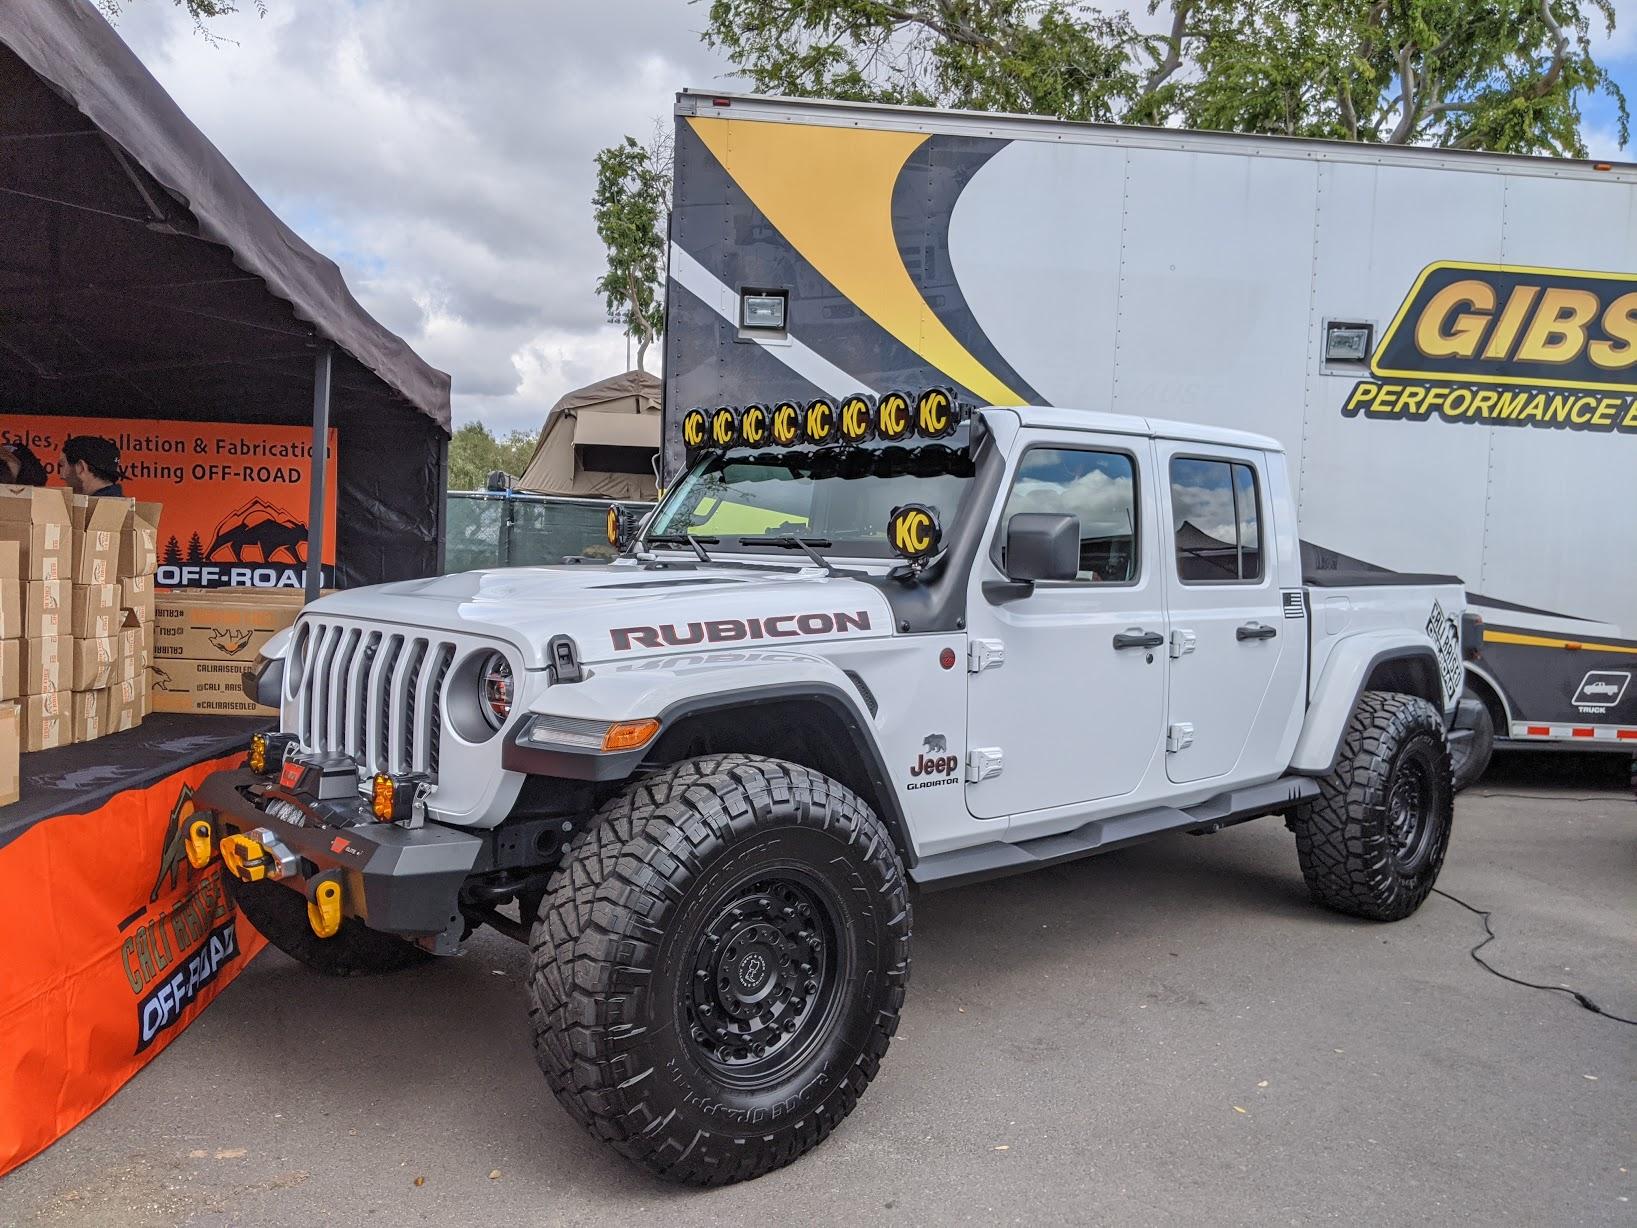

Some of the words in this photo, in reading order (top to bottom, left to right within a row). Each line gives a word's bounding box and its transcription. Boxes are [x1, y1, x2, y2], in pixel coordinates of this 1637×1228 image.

[808, 404, 830, 439] KC
[843, 401, 866, 437] KC
[881, 397, 905, 436] KC
[920, 395, 947, 433] KC
[1347, 383, 1622, 426] PERFORMANCE
[684, 412, 702, 445] KC
[713, 411, 732, 444] KC
[743, 409, 762, 443] KC
[774, 405, 795, 441] KC
[193, 437, 208, 454] &
[192, 463, 301, 483] OFF-ROAD
[896, 511, 930, 553] KC
[609, 610, 872, 651] RUBICON
[1578, 706, 1606, 714] TRUCK
[910, 753, 958, 777] Jeep
[907, 777, 959, 790] GLADIATOR
[120, 911, 174, 995] CALI
